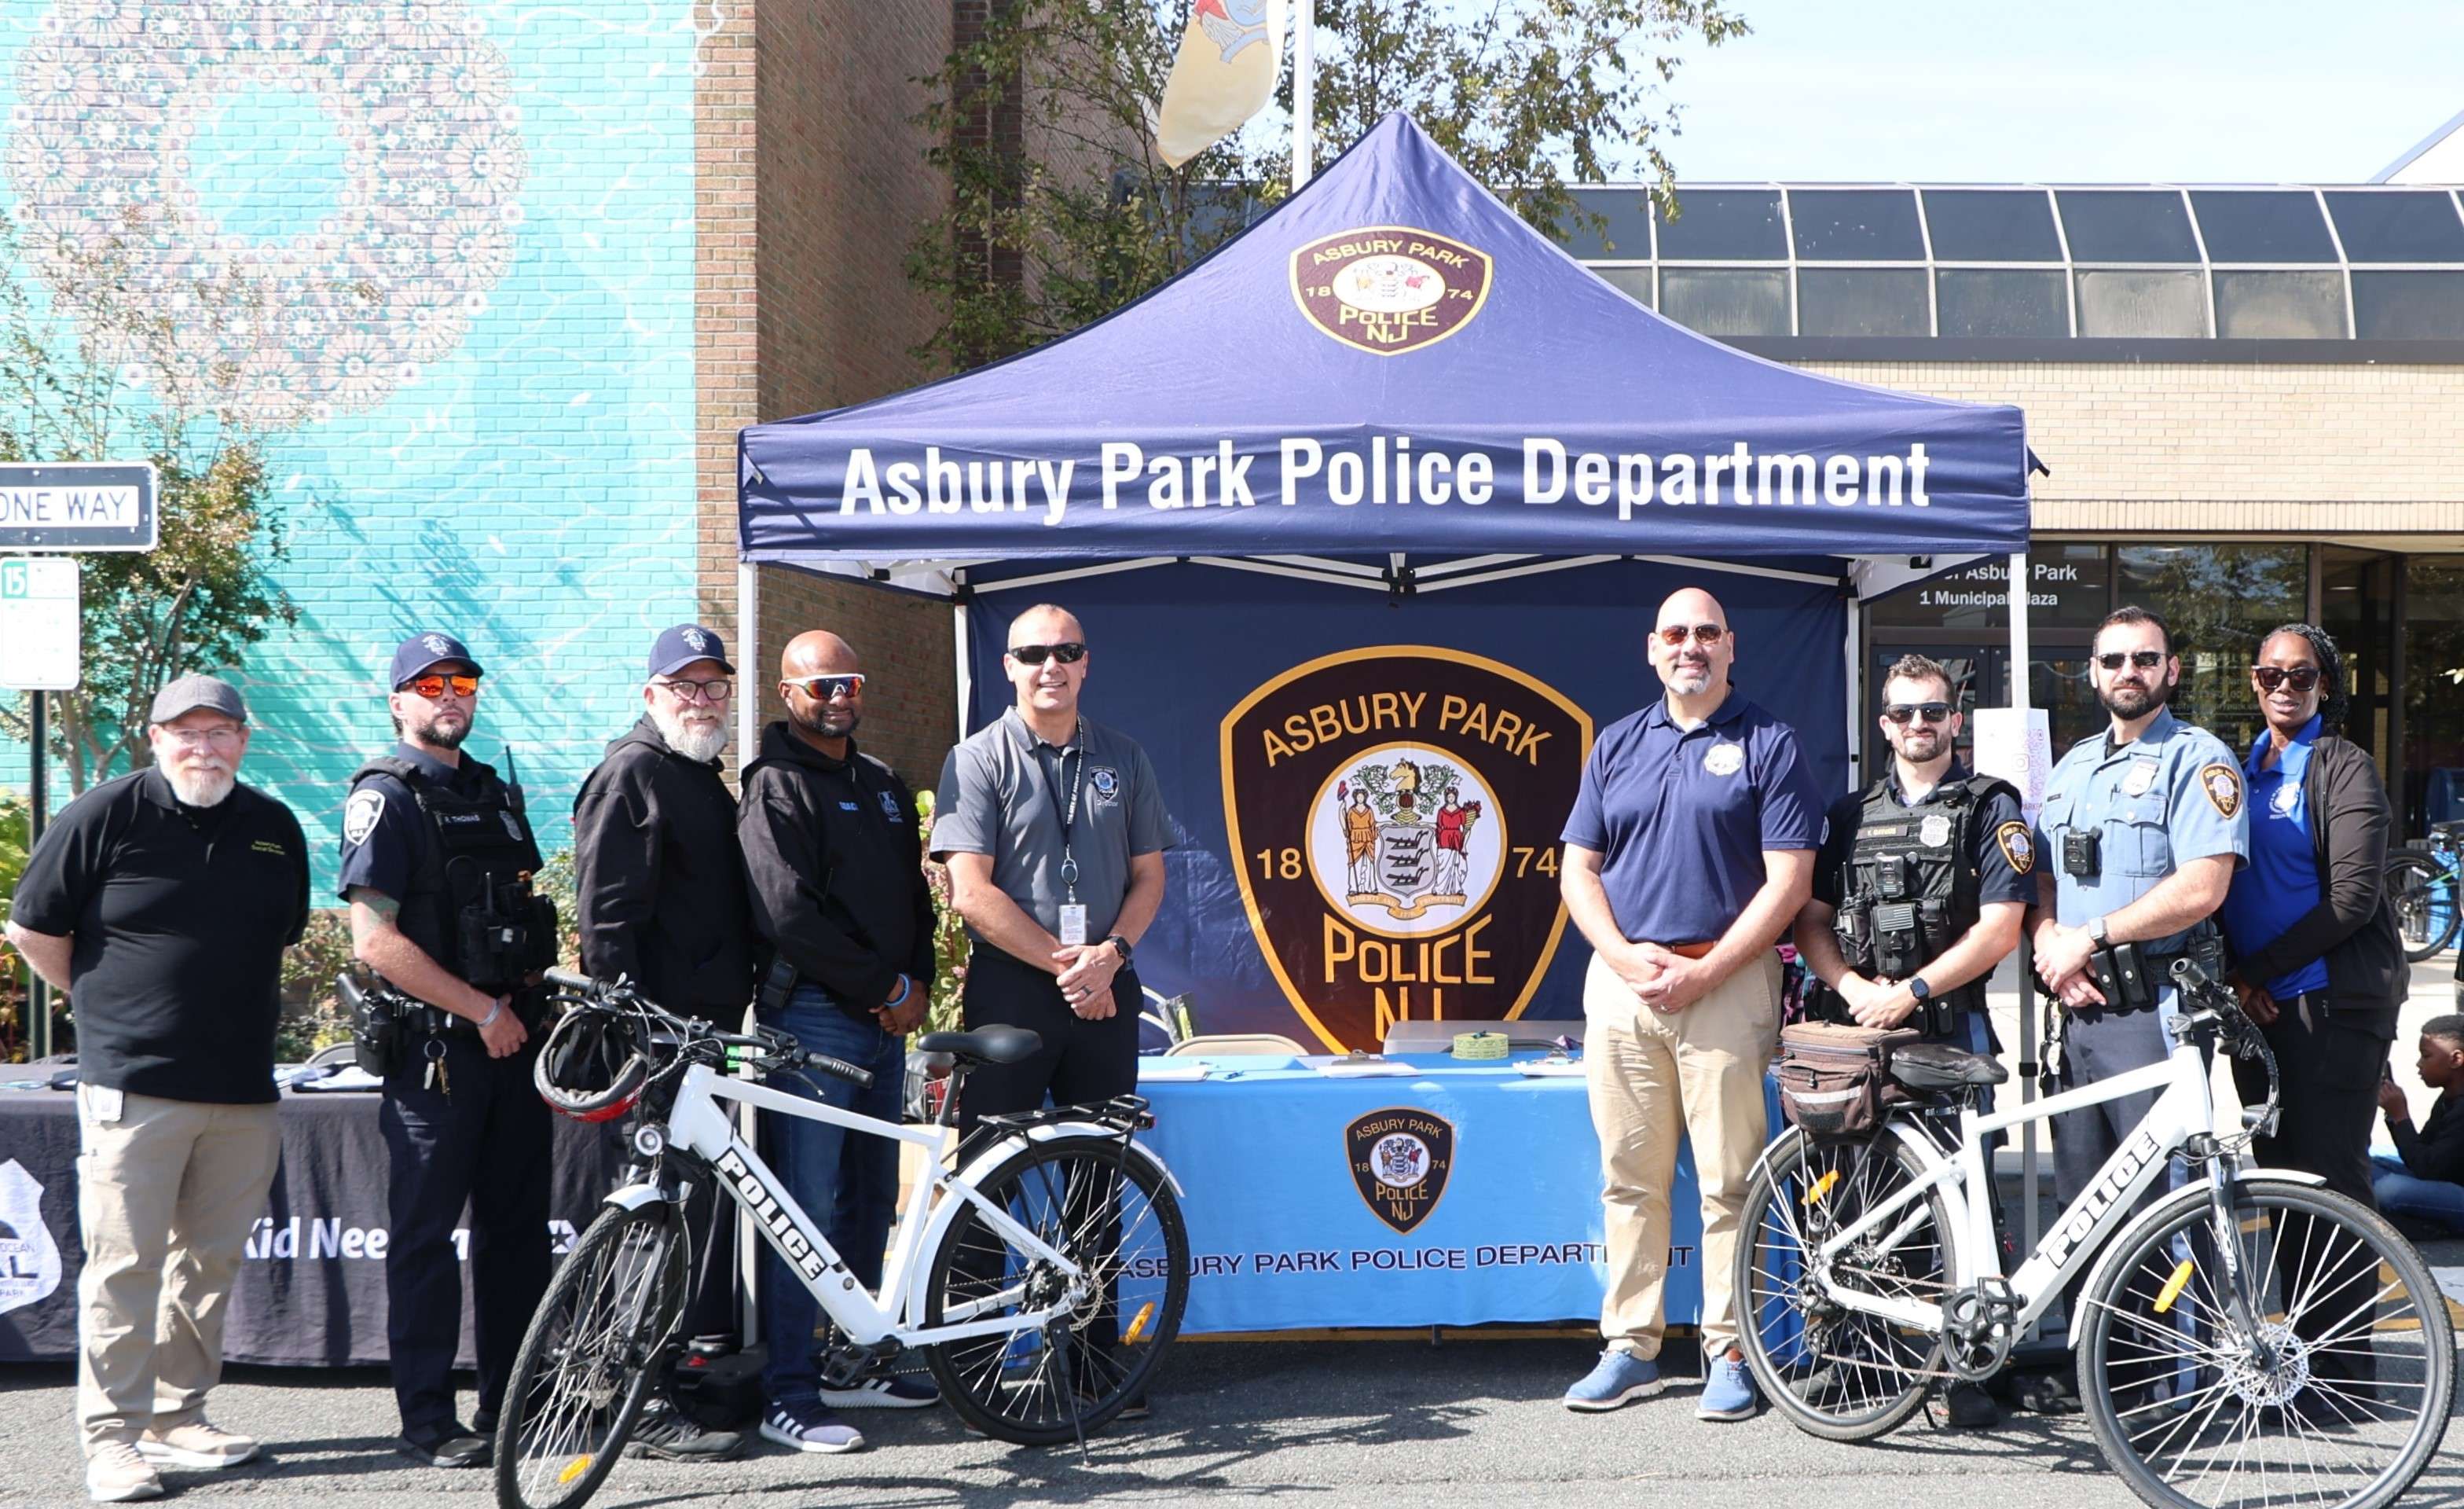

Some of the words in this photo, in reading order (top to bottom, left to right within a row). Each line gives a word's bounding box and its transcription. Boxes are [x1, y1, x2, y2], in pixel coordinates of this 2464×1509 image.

[1313, 240, 1403, 266] ASBURY
[1408, 242, 1469, 268] PARK
[1306, 287, 1332, 297] 18
[1446, 288, 1473, 300] 74
[1339, 304, 1439, 326] POLICE
[1366, 324, 1409, 343] NJ
[839, 448, 1075, 526] Asbury
[1101, 439, 1256, 509] Park
[1280, 436, 1493, 507] Police
[1524, 438, 1930, 521] Department
[66, 492, 126, 520] WAY
[4, 566, 26, 596] 15
[1966, 564, 2030, 582] Asbu
[2034, 564, 2077, 581] Park
[1920, 591, 1930, 605] 1
[1935, 590, 2010, 608] Municipal
[2027, 591, 2058, 605] laza
[1263, 692, 1427, 767] ASBURY
[1439, 695, 1553, 766] PARK
[1257, 847, 1302, 880] 18
[1512, 846, 1559, 879] 74
[1324, 913, 1496, 985] POLICE
[1356, 1118, 1406, 1141] ASBURY
[1409, 1119, 1443, 1139] PARK
[1355, 1162, 1370, 1173] 18
[1432, 1159, 1447, 1170] 74
[1376, 1179, 1428, 1201] POLICE
[2047, 1132, 2161, 1269] POLICE
[716, 1147, 828, 1281] POLICE
[1392, 1201, 1414, 1221] NJ
[309, 1217, 388, 1259] Nee
[1253, 1249, 1342, 1274] PARK
[1351, 1246, 1468, 1271] POLICE
[1476, 1243, 1694, 1268] DEPARTT
